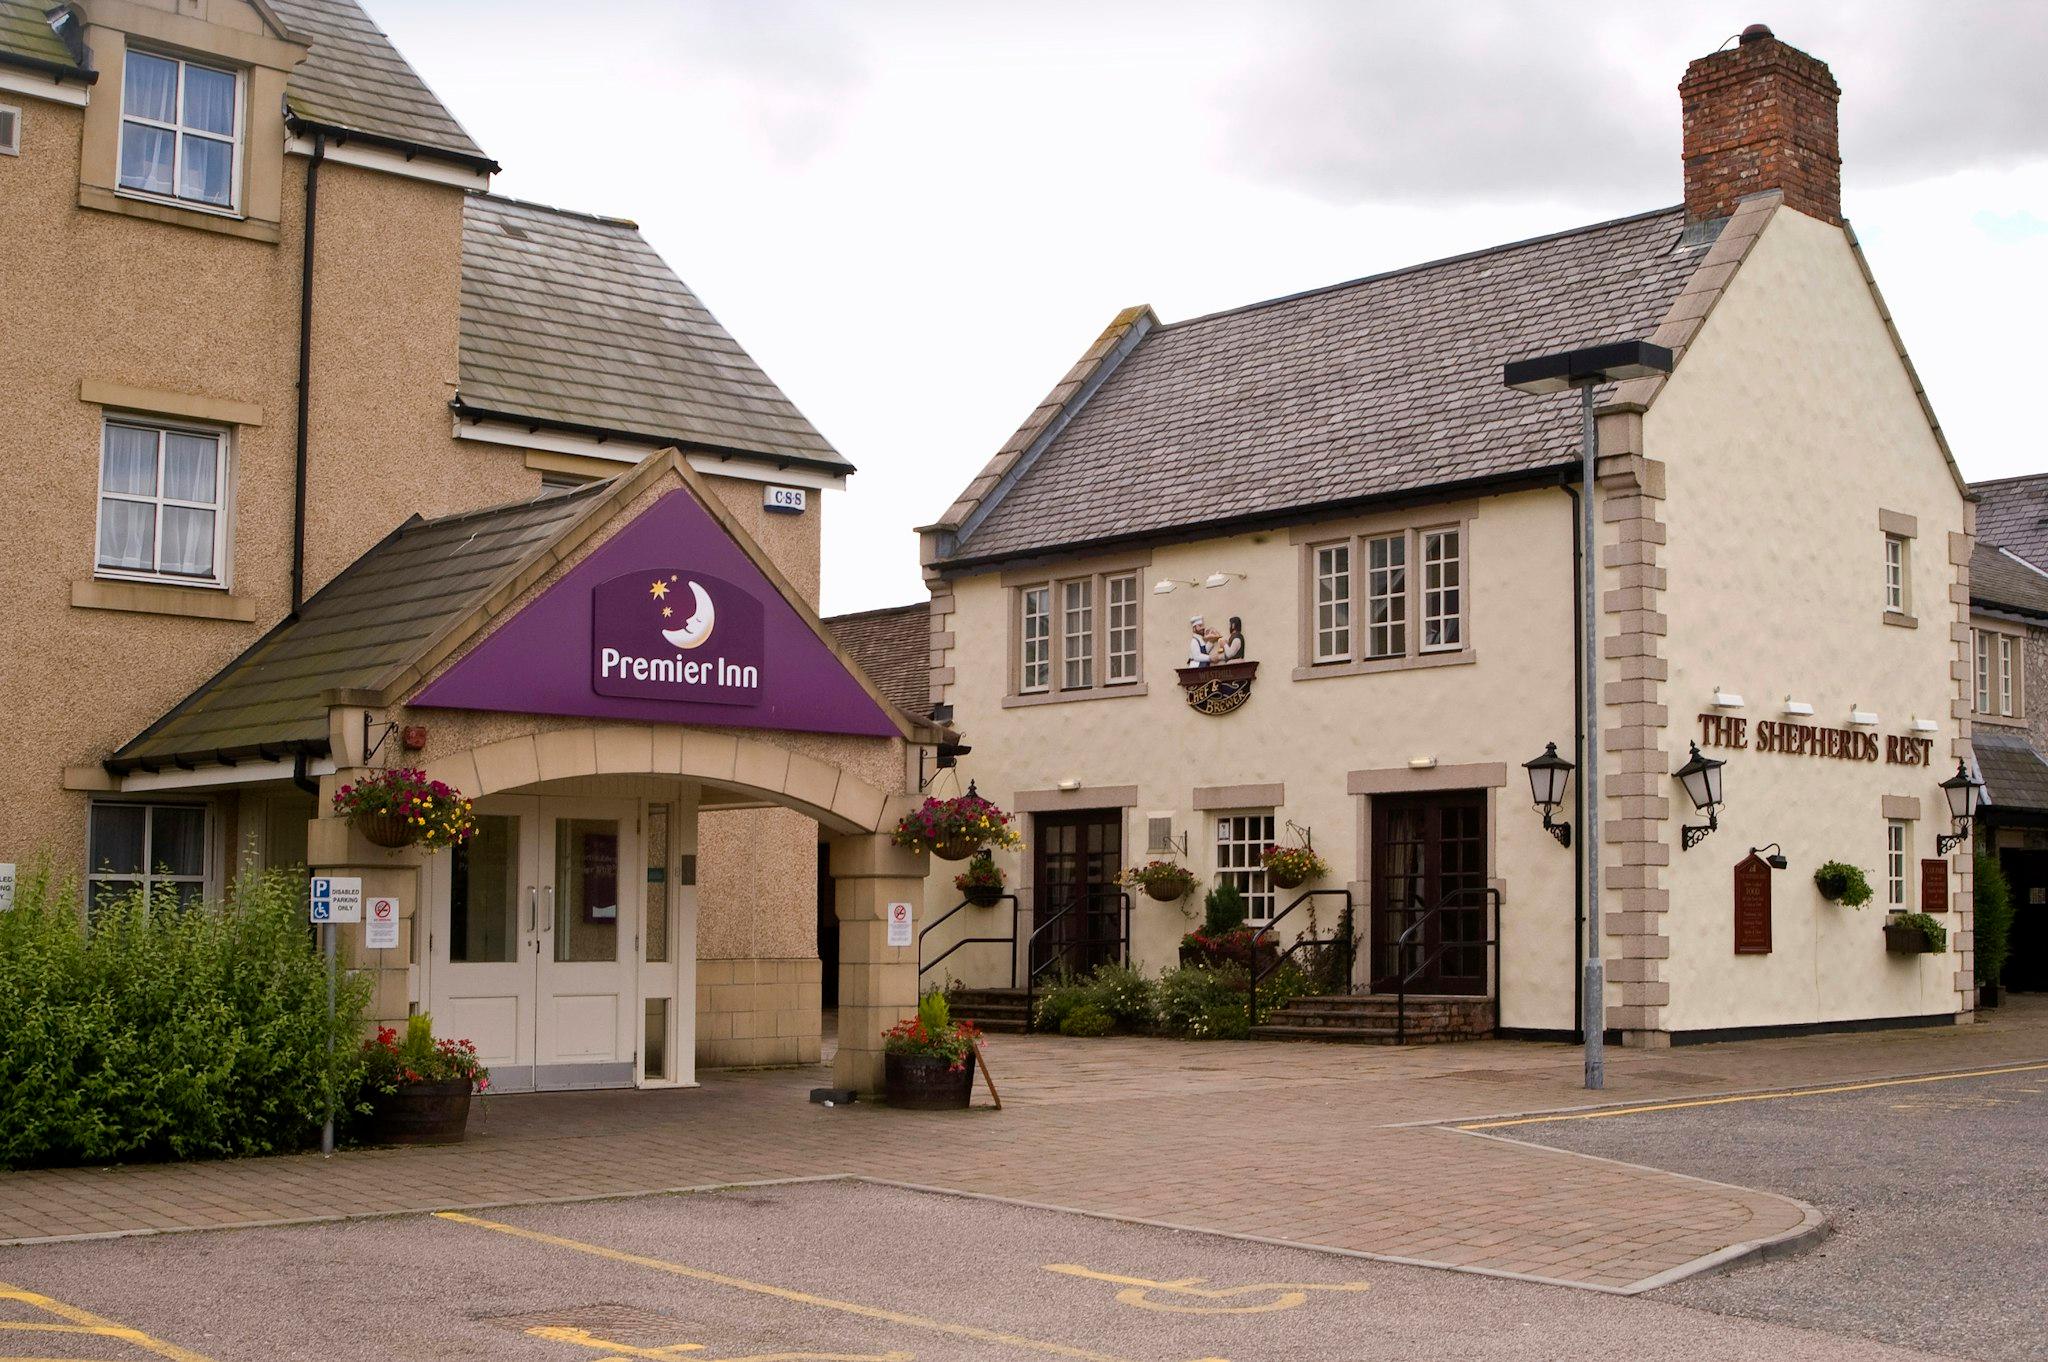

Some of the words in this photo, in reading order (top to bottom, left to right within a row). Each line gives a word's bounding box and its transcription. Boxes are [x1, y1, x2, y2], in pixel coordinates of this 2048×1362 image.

[602, 647, 713, 685] Premier
[718, 657, 758, 688] Inn
[1187, 687, 1209, 705] CHEF
[1206, 690, 1246, 714] BREWER
[1698, 713, 1748, 749] THE
[1756, 720, 1879, 762] SHEPHERDS
[1886, 734, 1934, 767] REST
[316, 880, 328, 897] P
